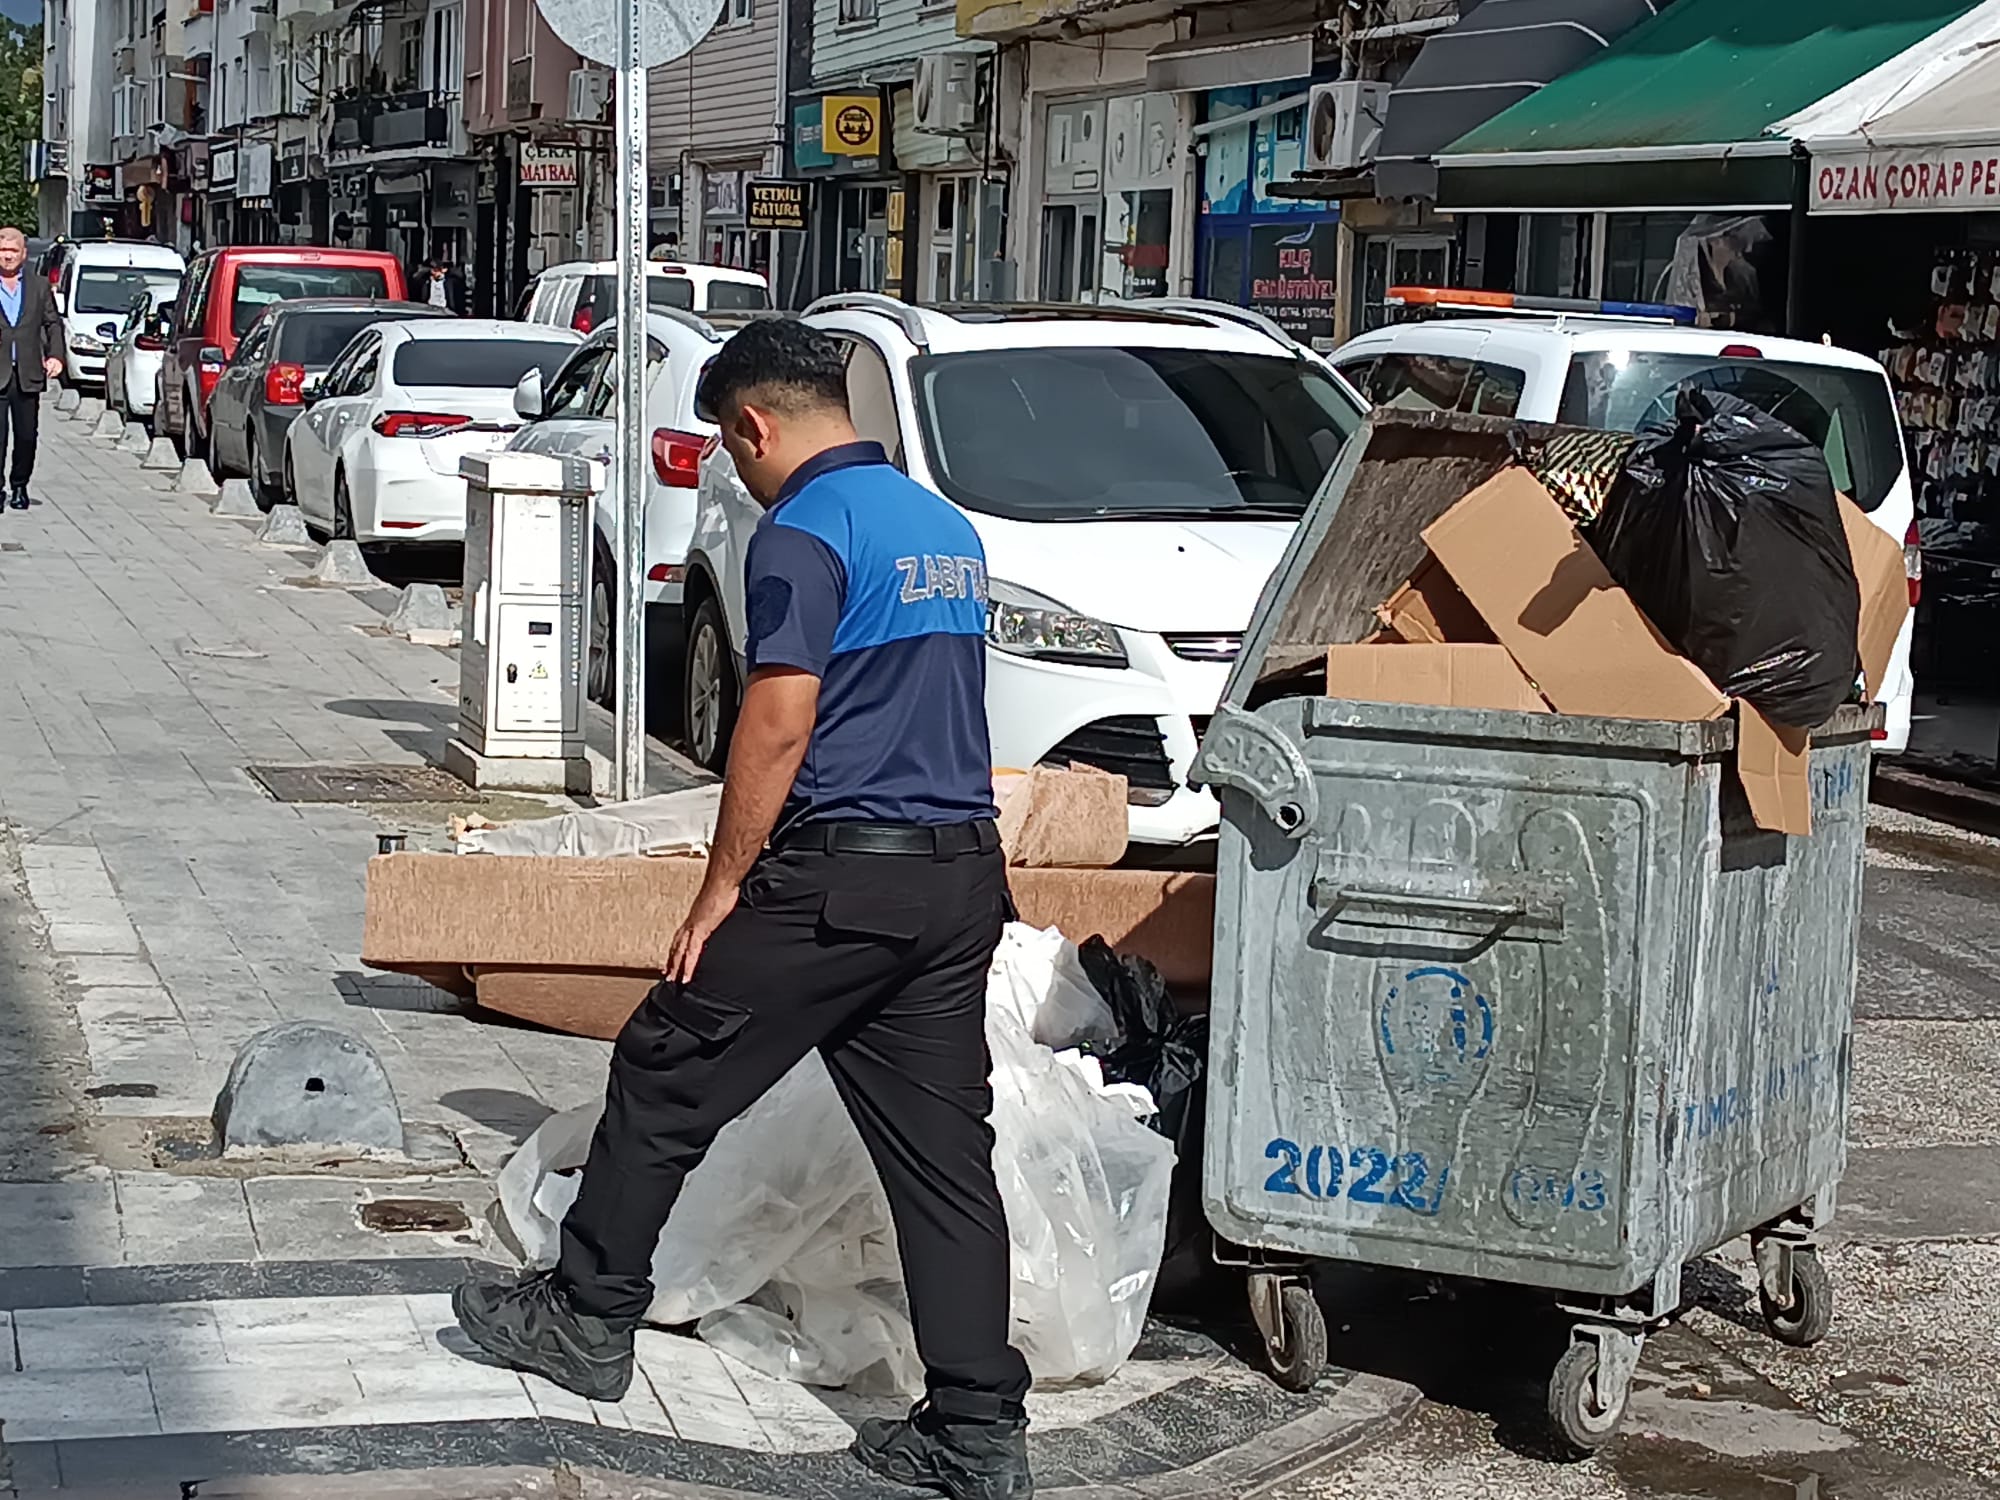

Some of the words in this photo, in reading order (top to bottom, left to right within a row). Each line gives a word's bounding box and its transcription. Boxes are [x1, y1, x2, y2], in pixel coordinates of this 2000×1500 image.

[1819, 165, 1878, 200] OZAN
[1885, 162, 1964, 208] ÇORAP
[1970, 159, 2000, 195] PE
[752, 202, 801, 217] FATURA
